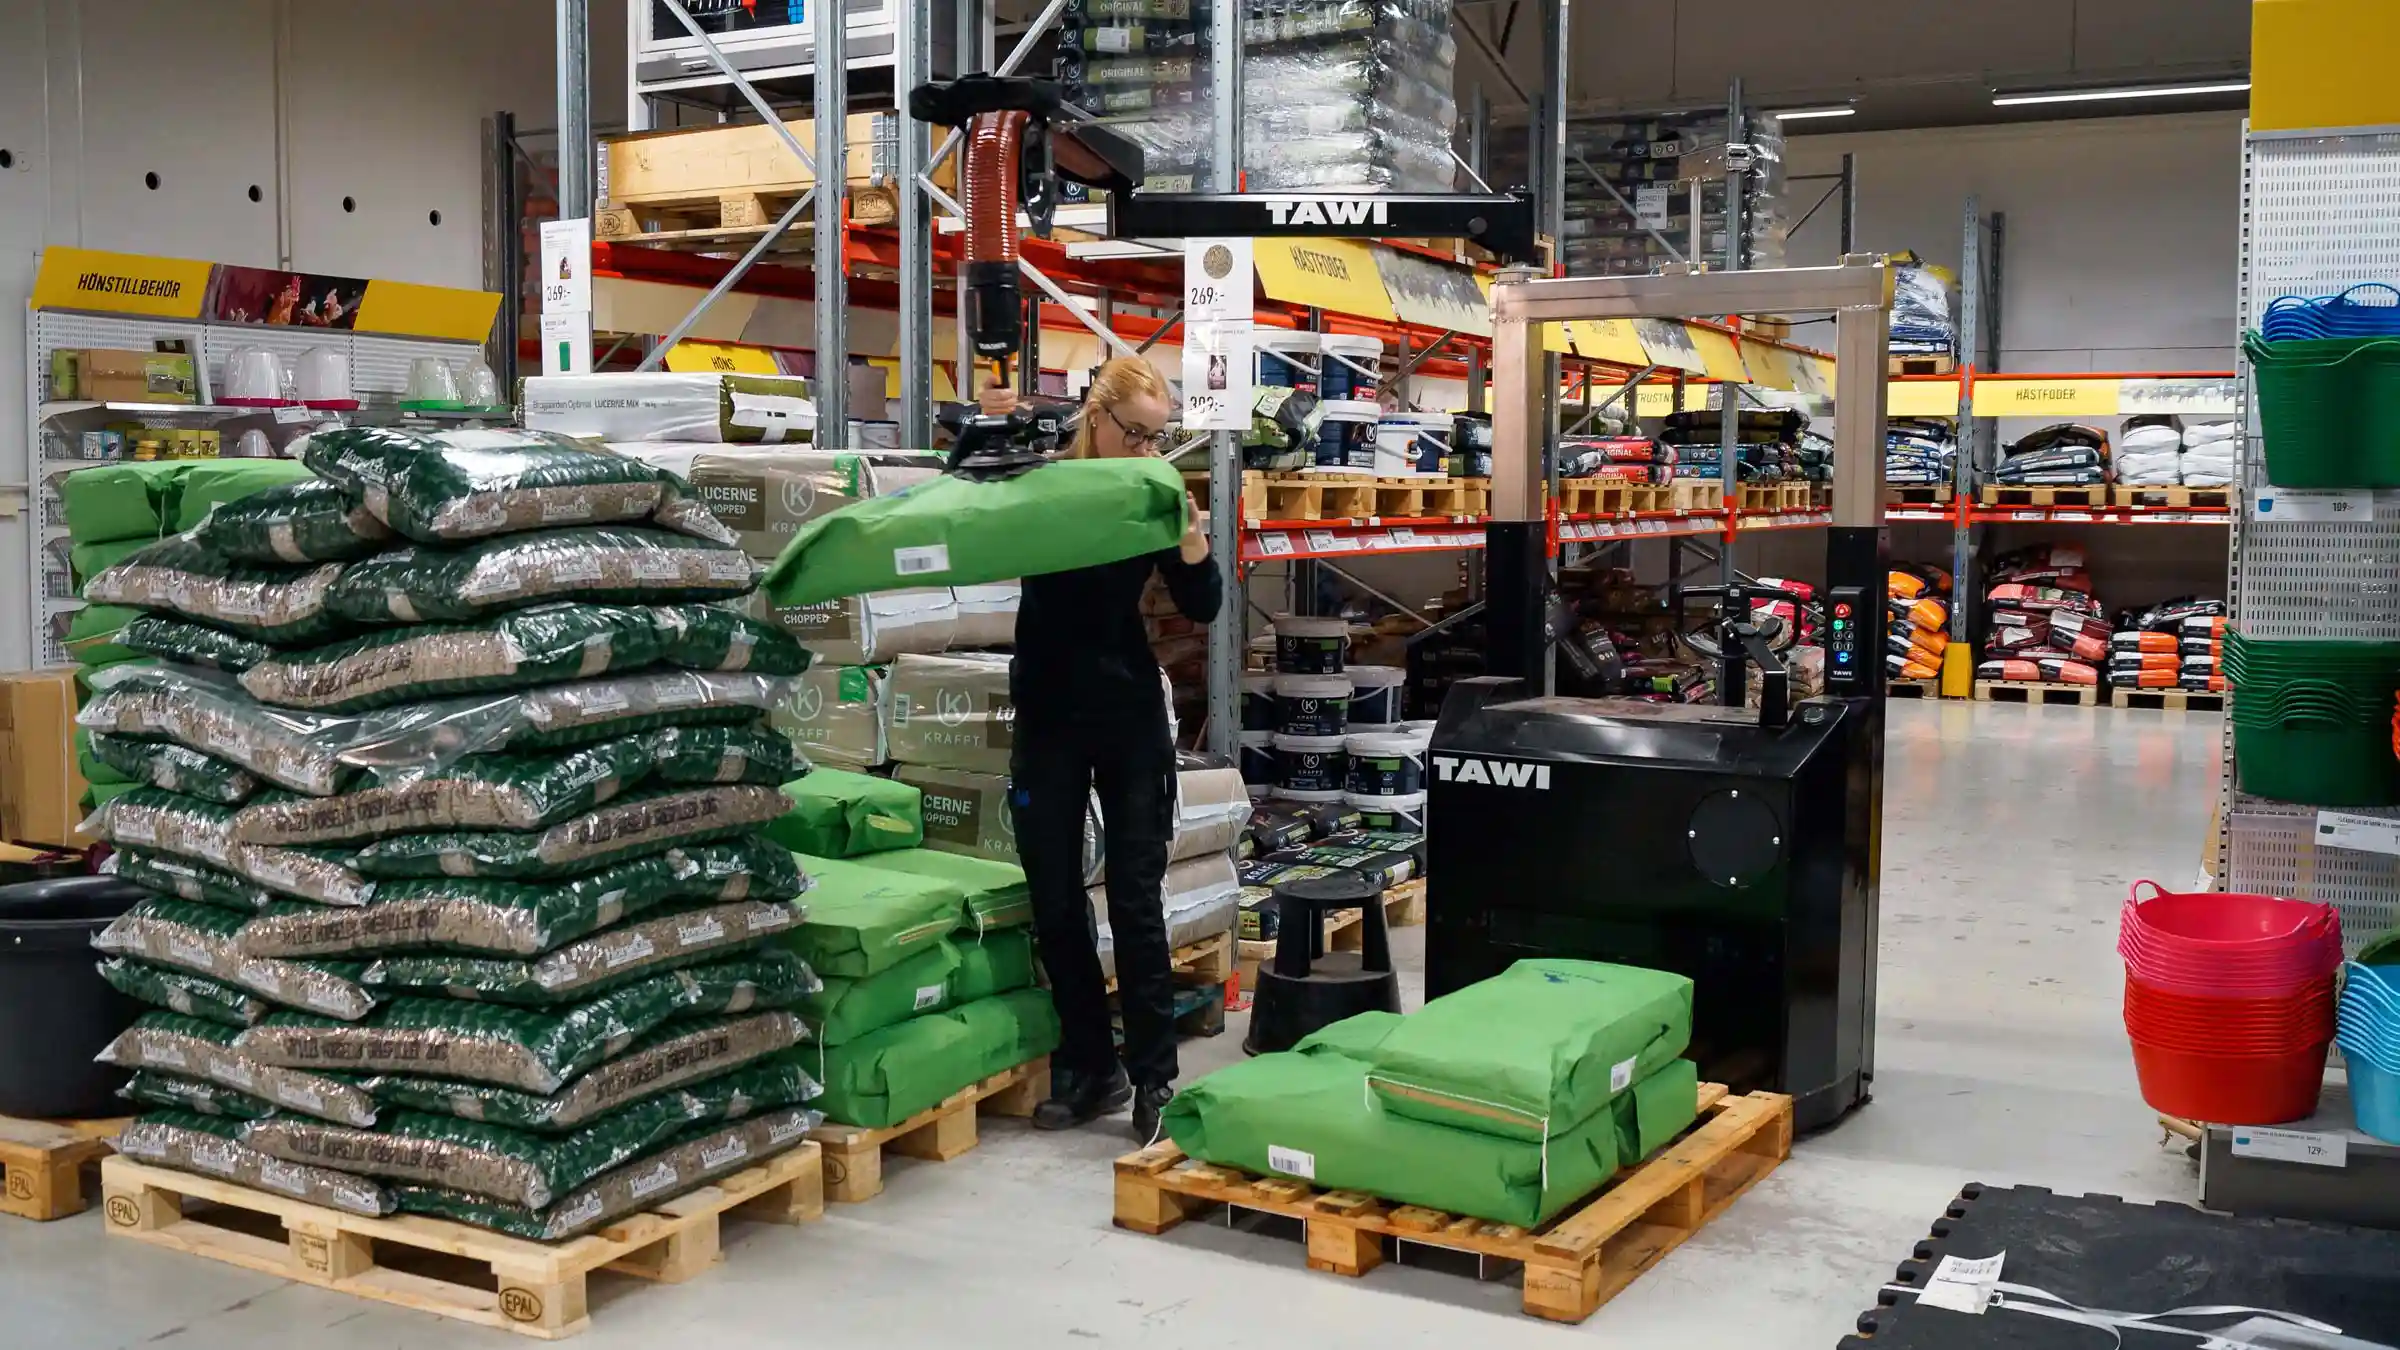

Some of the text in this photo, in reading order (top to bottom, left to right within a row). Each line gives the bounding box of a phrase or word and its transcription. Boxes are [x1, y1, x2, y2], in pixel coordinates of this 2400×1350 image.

[1266, 202, 1387, 224] TAWI
[601, 217, 616, 229] PAL
[78, 272, 180, 298] HÖNSTILLBEHÖR
[1192, 287, 1225, 306] 269:-
[711, 356, 736, 371] HÖNS
[594, 398, 625, 408] LUCERNE
[626, 399, 639, 408] MIX
[703, 486, 758, 502] UCERNE
[710, 503, 747, 515] HOPPED
[771, 522, 800, 534] KRA
[783, 612, 830, 625] CHOPPED
[923, 730, 980, 747] KRAFFT
[1433, 756, 1550, 790] TAWI
[923, 794, 972, 815] CERNE
[925, 813, 959, 826] OPPED
[983, 838, 1013, 853] KRA
[10, 1175, 32, 1199] EPAL
[111, 1200, 134, 1225] EPAL
[504, 1292, 536, 1317] EPAL
